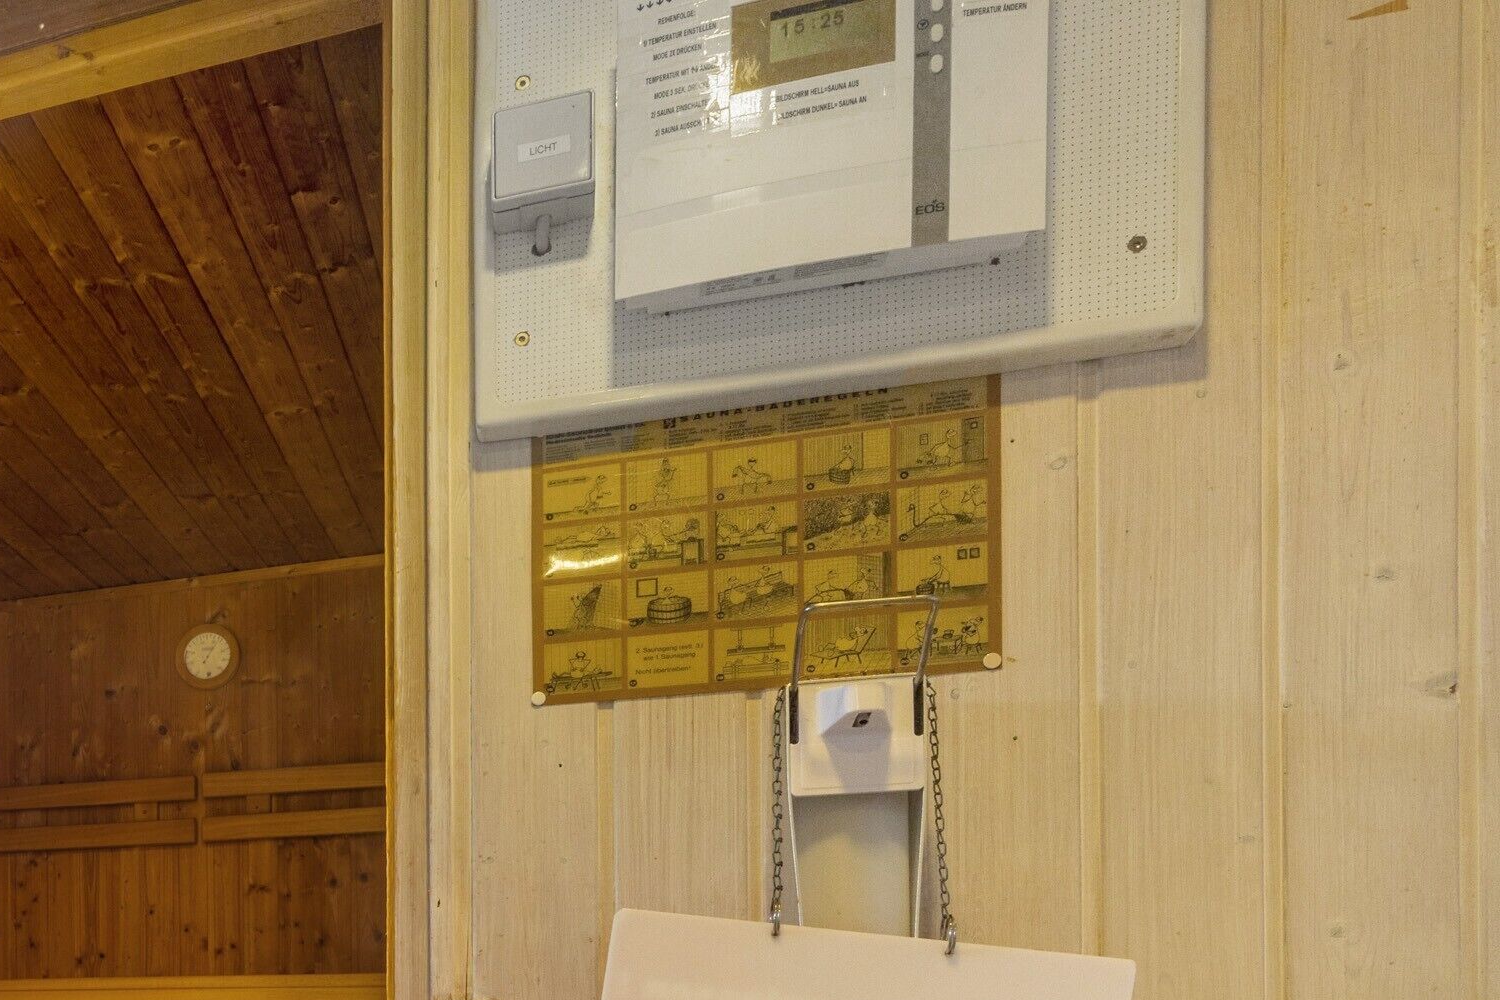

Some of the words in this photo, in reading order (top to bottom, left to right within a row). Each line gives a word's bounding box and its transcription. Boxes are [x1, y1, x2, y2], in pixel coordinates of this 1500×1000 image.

[657, 9, 697, 25] REIHENFOLGE:
[963, 4, 1001, 17] TEMPERATUR
[1002, 2, 1028, 12] ÄNDERN
[648, 31, 683, 46] TEMPERATUR
[683, 22, 717, 37] EINSTELLEN
[653, 51, 668, 61] MODE
[676, 43, 703, 56] DRÜCKEN
[645, 70, 680, 85] TEMPERATUR
[654, 89, 669, 100] MODE
[775, 89, 809, 103] BILDSCHIRM
[848, 79, 860, 88] AUS
[656, 107, 675, 117] SAUNA
[675, 98, 710, 113] EINSCHALTE
[778, 107, 811, 121] ILDSCHIRM
[838, 97, 858, 107] SAUNA
[858, 95, 867, 103] AN
[660, 124, 679, 135] SAUNA
[529, 141, 558, 156] LICHT
[915, 200, 945, 215] EOS
